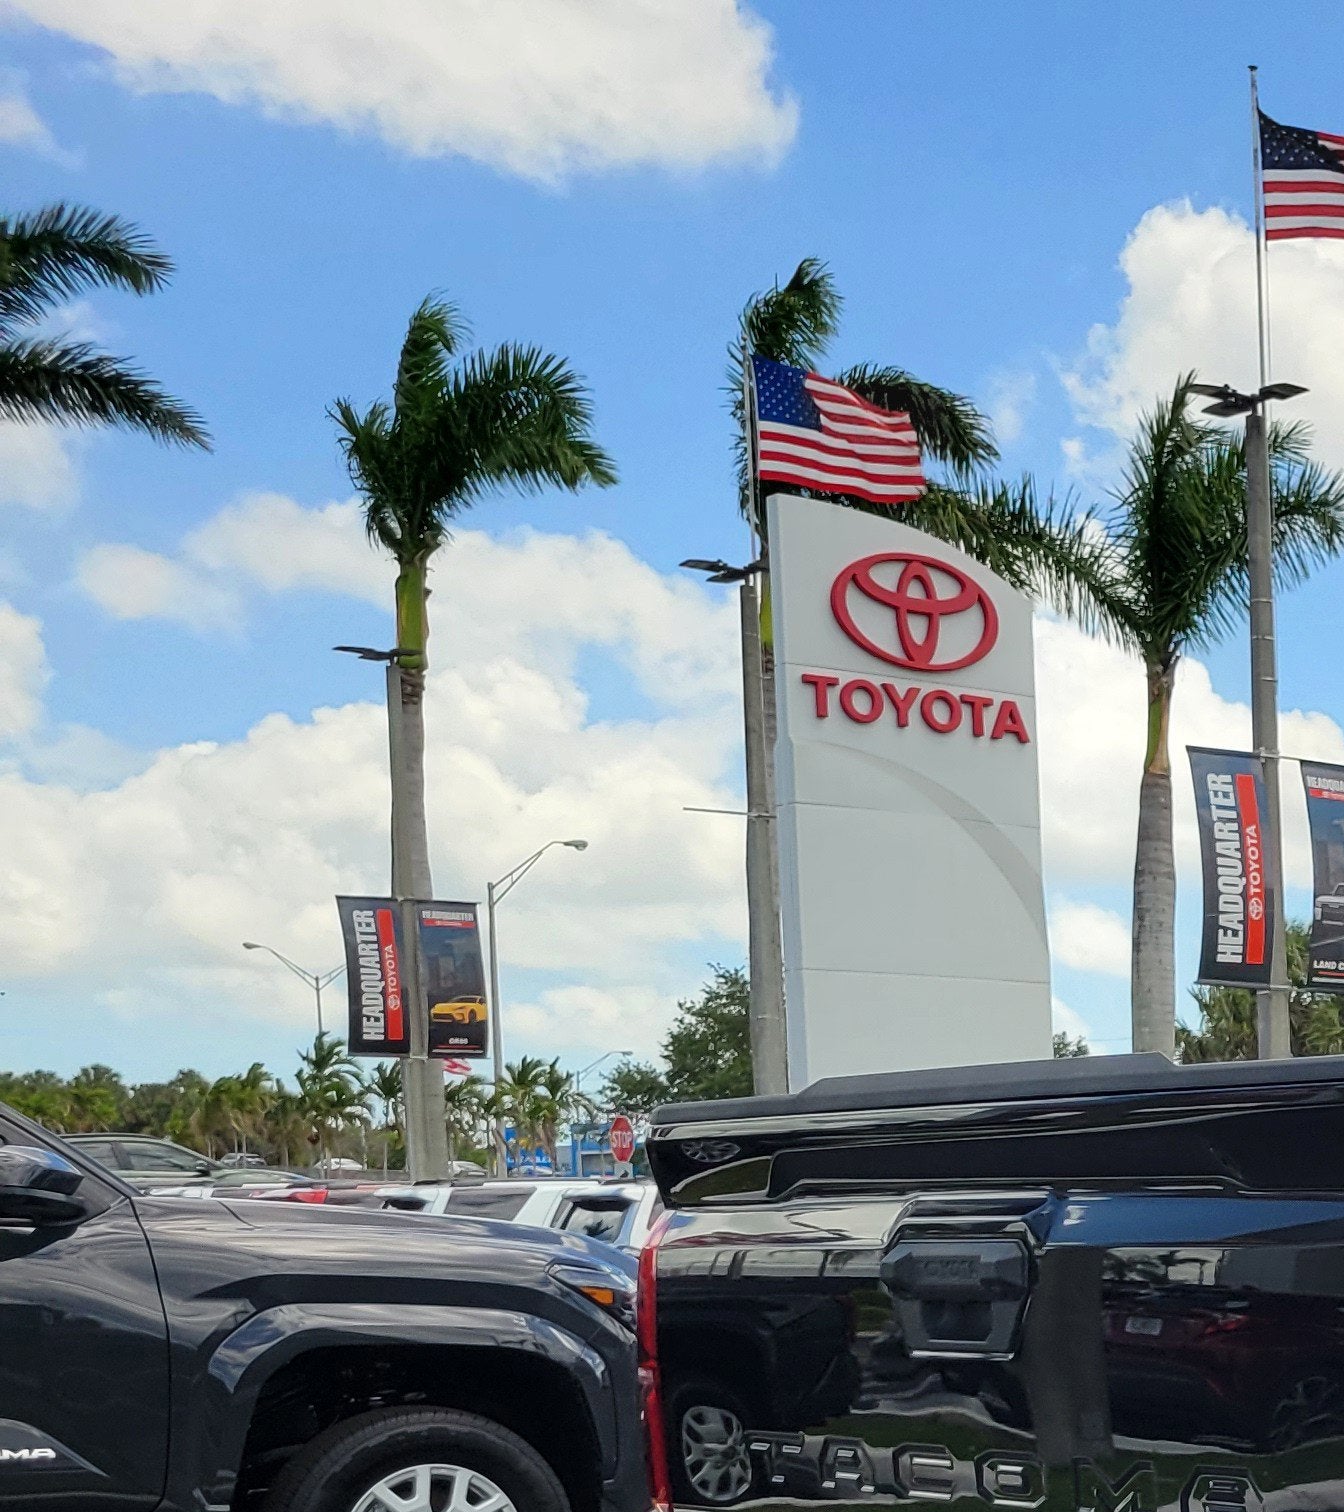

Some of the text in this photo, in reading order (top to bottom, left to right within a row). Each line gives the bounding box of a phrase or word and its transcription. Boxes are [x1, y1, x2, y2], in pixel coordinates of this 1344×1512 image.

[802, 673, 1030, 743] TOYOTA
[1206, 773, 1246, 963] HEADQUARTER
[1245, 825, 1262, 896] TOYOTA
[352, 909, 386, 1041] HEADQUARTER
[384, 943, 398, 993] TOYOTA
[611, 1130, 633, 1149] STOP
